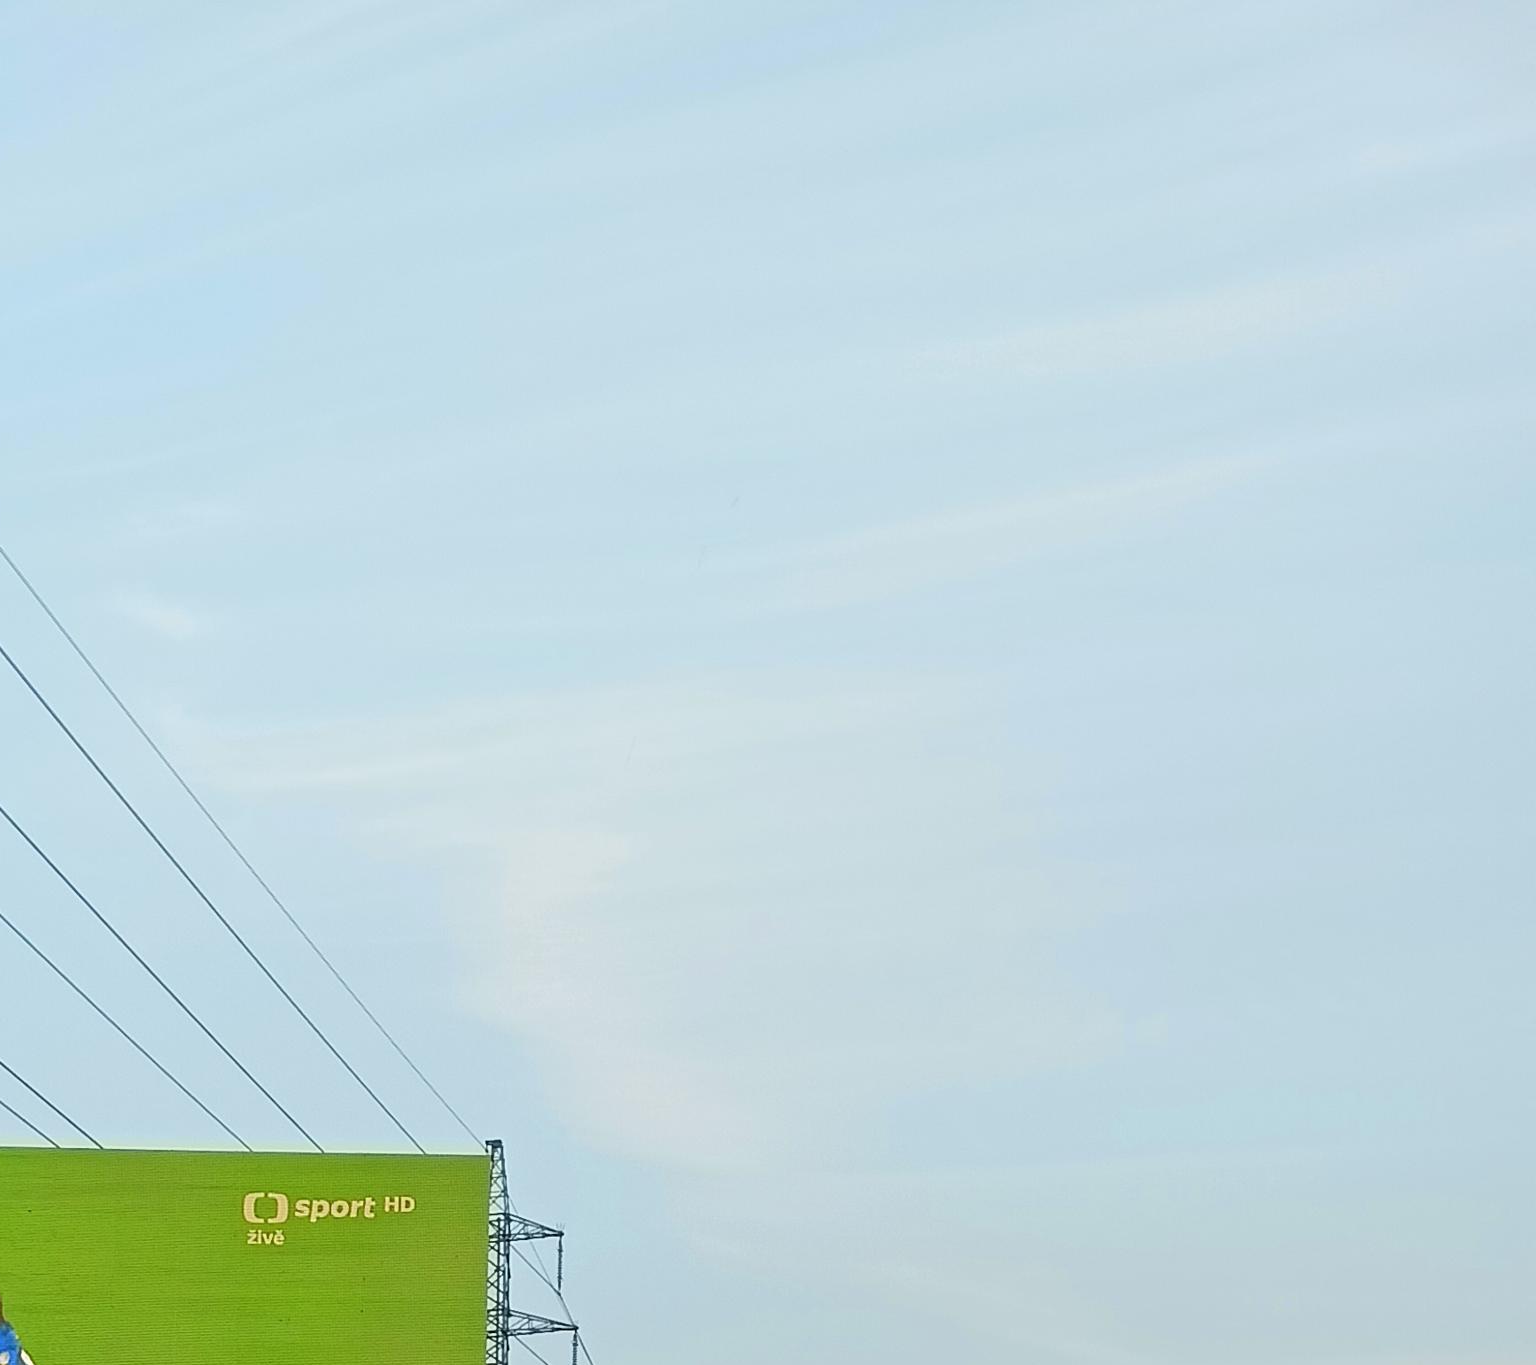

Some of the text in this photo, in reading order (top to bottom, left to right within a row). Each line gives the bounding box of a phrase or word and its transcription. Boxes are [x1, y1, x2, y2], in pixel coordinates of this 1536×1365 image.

[294, 1196, 415, 1222] sport HD
[247, 1229, 285, 1245] živě
